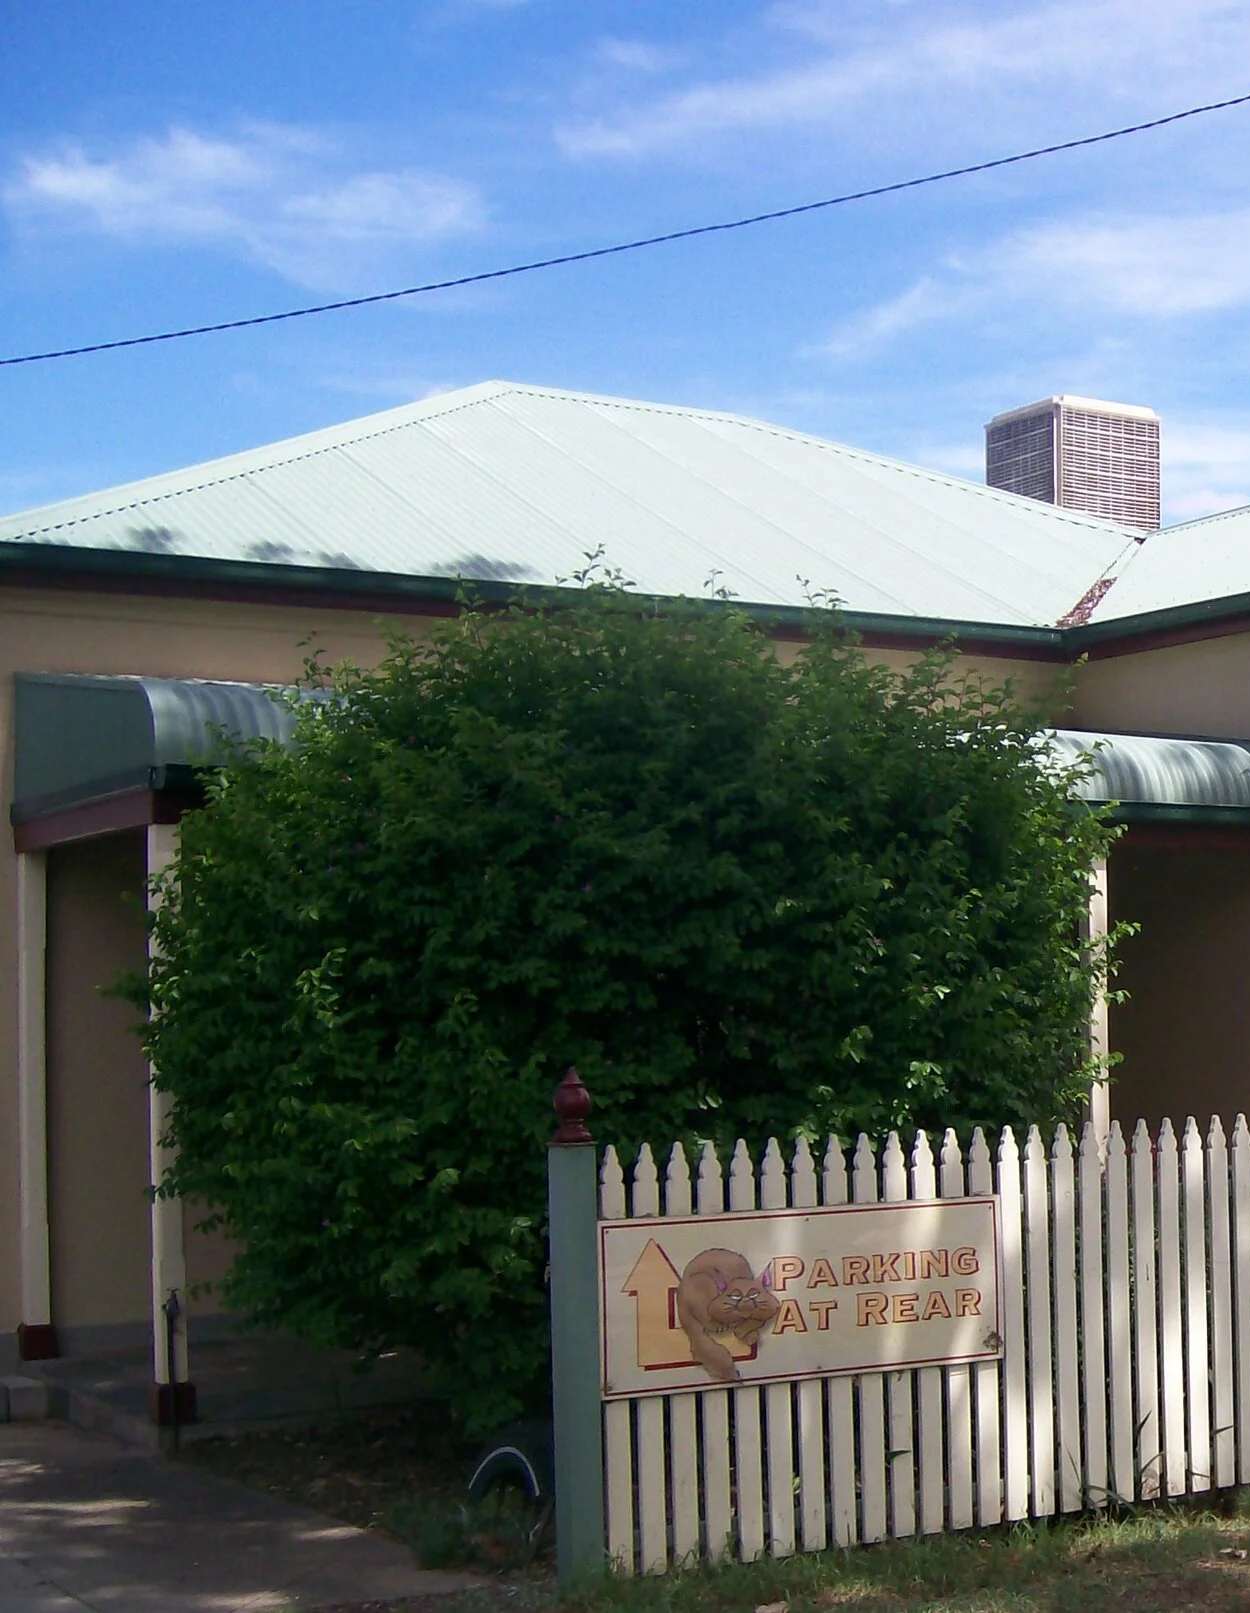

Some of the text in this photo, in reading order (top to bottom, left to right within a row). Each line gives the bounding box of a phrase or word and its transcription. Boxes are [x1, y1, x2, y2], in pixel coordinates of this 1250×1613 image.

[772, 1247, 980, 1292] PARKING
[772, 1287, 982, 1335] AT REAR
